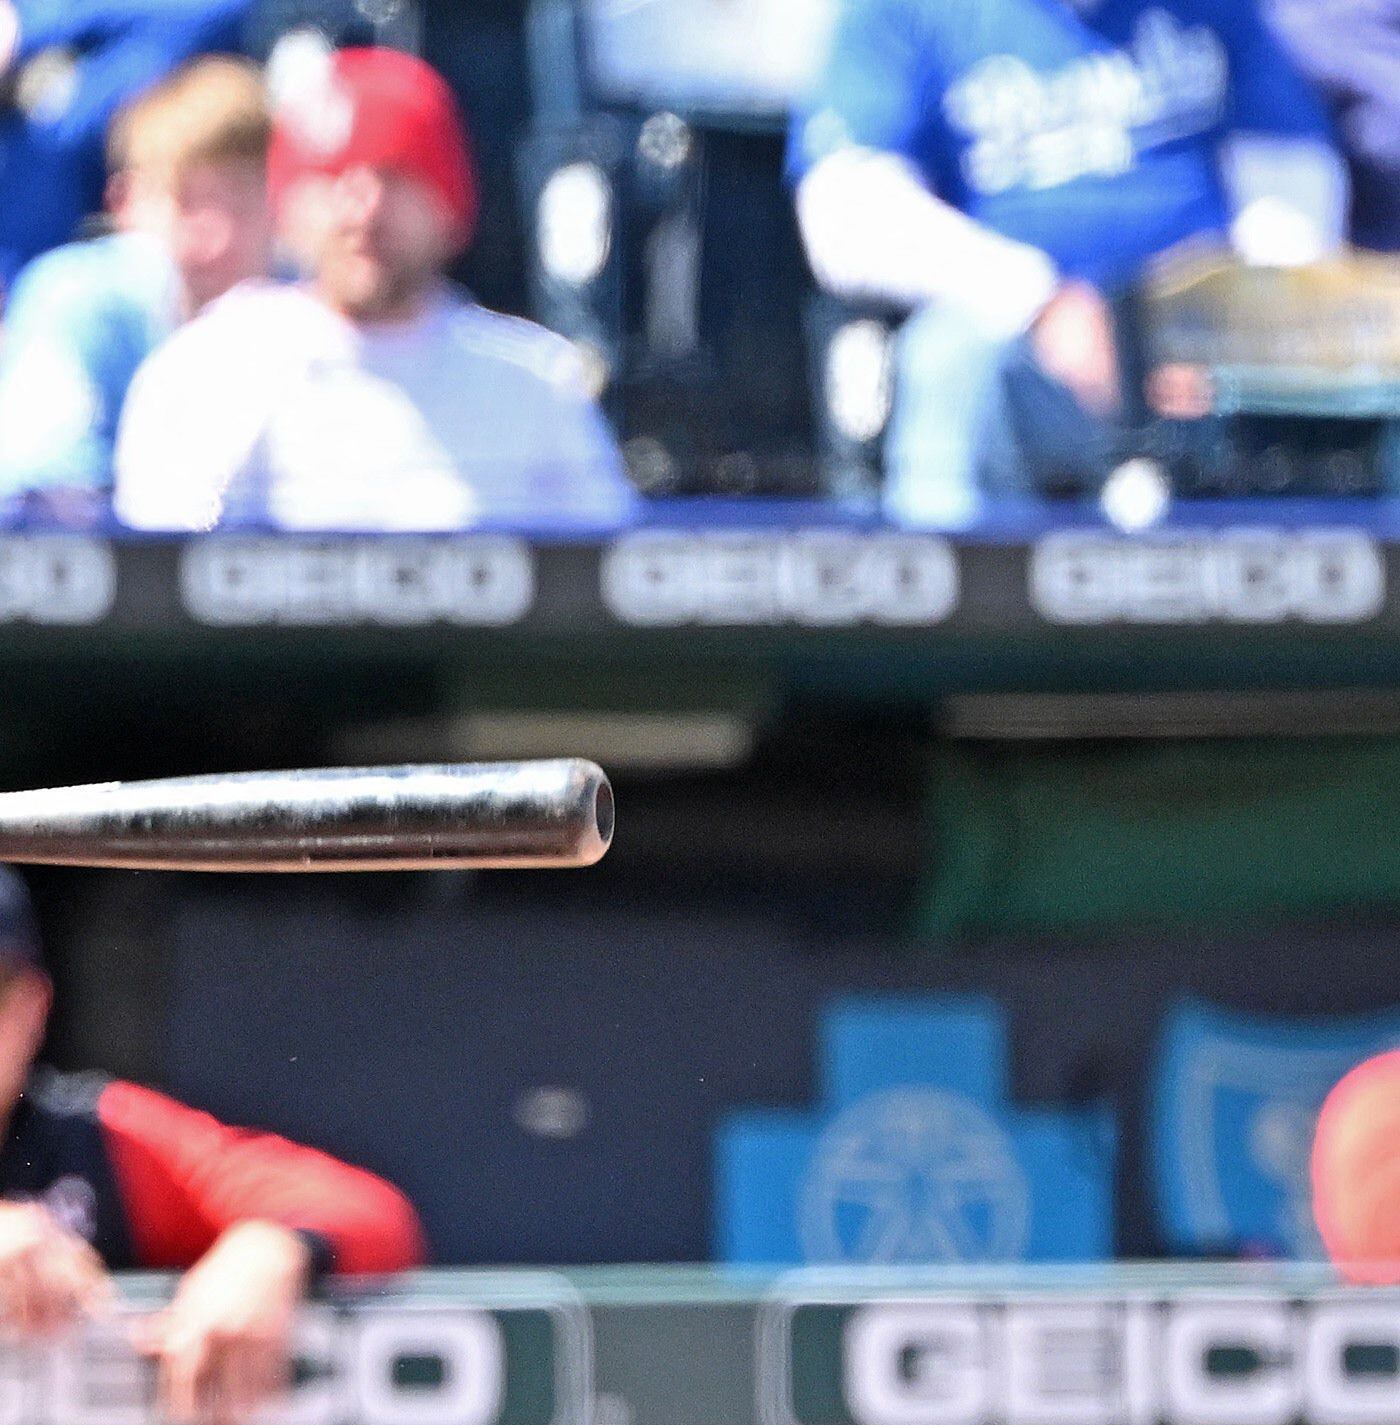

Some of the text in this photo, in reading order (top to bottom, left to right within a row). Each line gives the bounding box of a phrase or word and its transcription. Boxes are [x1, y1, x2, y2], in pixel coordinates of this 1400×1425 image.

[182, 534, 533, 624] GEICO
[605, 532, 957, 623] GEICO
[1030, 530, 1382, 622] GEICO
